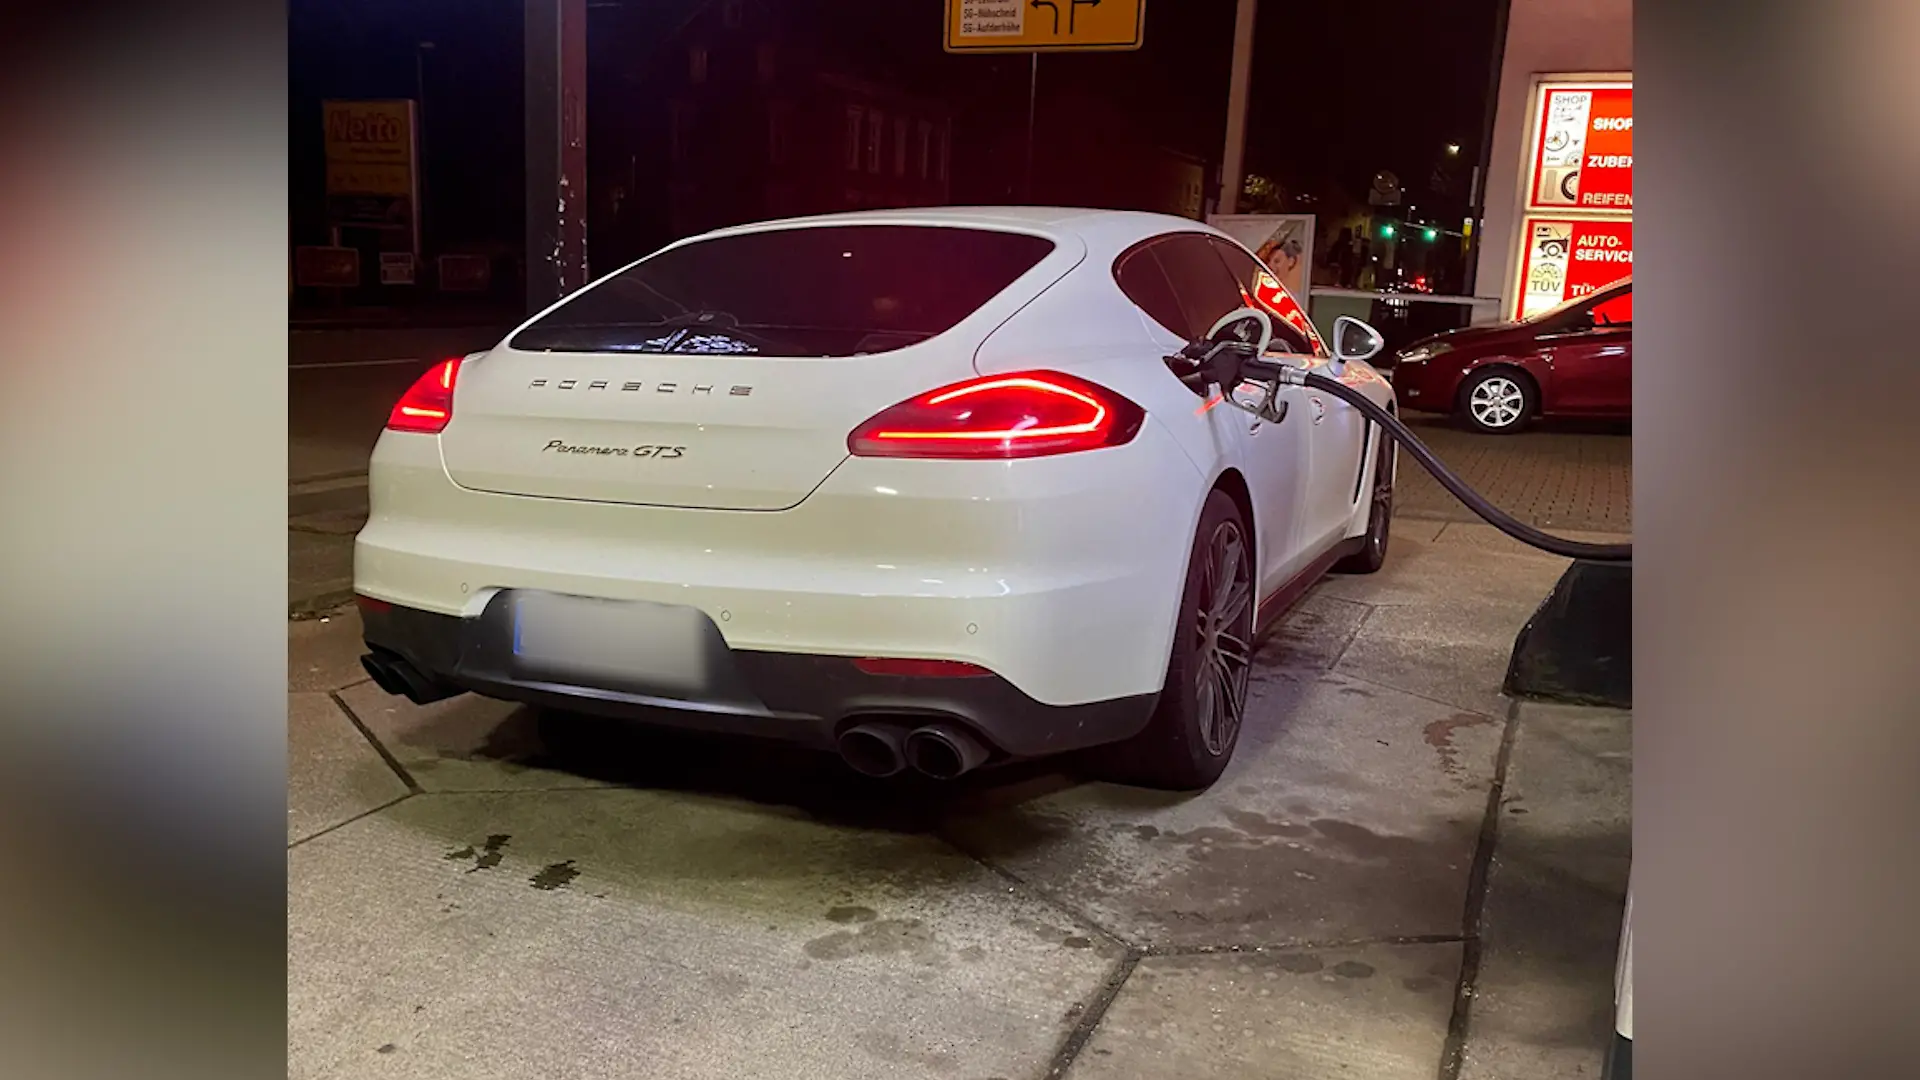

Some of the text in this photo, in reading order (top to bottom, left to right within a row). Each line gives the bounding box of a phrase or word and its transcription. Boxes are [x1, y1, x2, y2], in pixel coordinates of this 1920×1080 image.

[1555, 95, 1588, 105] SHOP
[329, 110, 402, 143] Netto
[1593, 117, 1633, 131] SHOP
[1582, 192, 1633, 206] REIFEN
[1577, 235, 1623, 248] AUTO-
[1532, 280, 1561, 292] TÜV
[528, 380, 753, 396] PORSCHE
[542, 440, 687, 458] Panamera GTS
